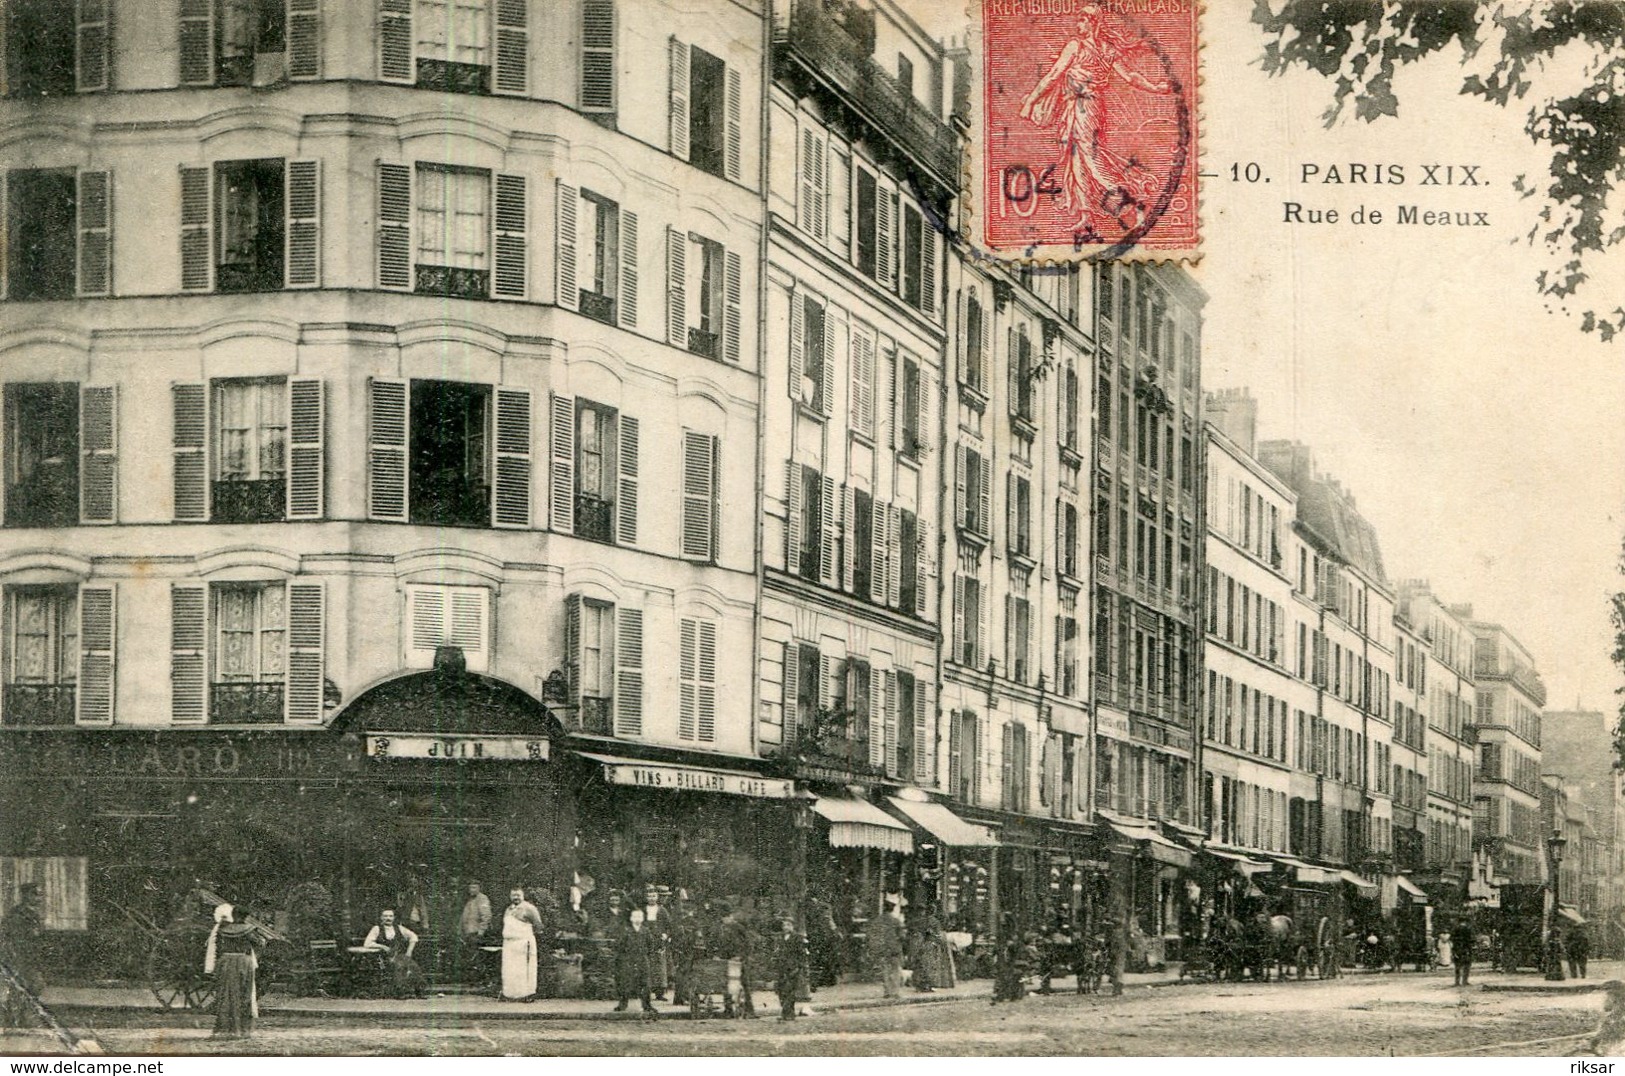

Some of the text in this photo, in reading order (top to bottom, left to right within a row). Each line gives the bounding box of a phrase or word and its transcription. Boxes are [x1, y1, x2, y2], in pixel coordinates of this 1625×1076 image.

[428, 742, 483, 758] JUIN
[633, 769, 662, 786] VINS
[676, 772, 725, 791] BILLARD
